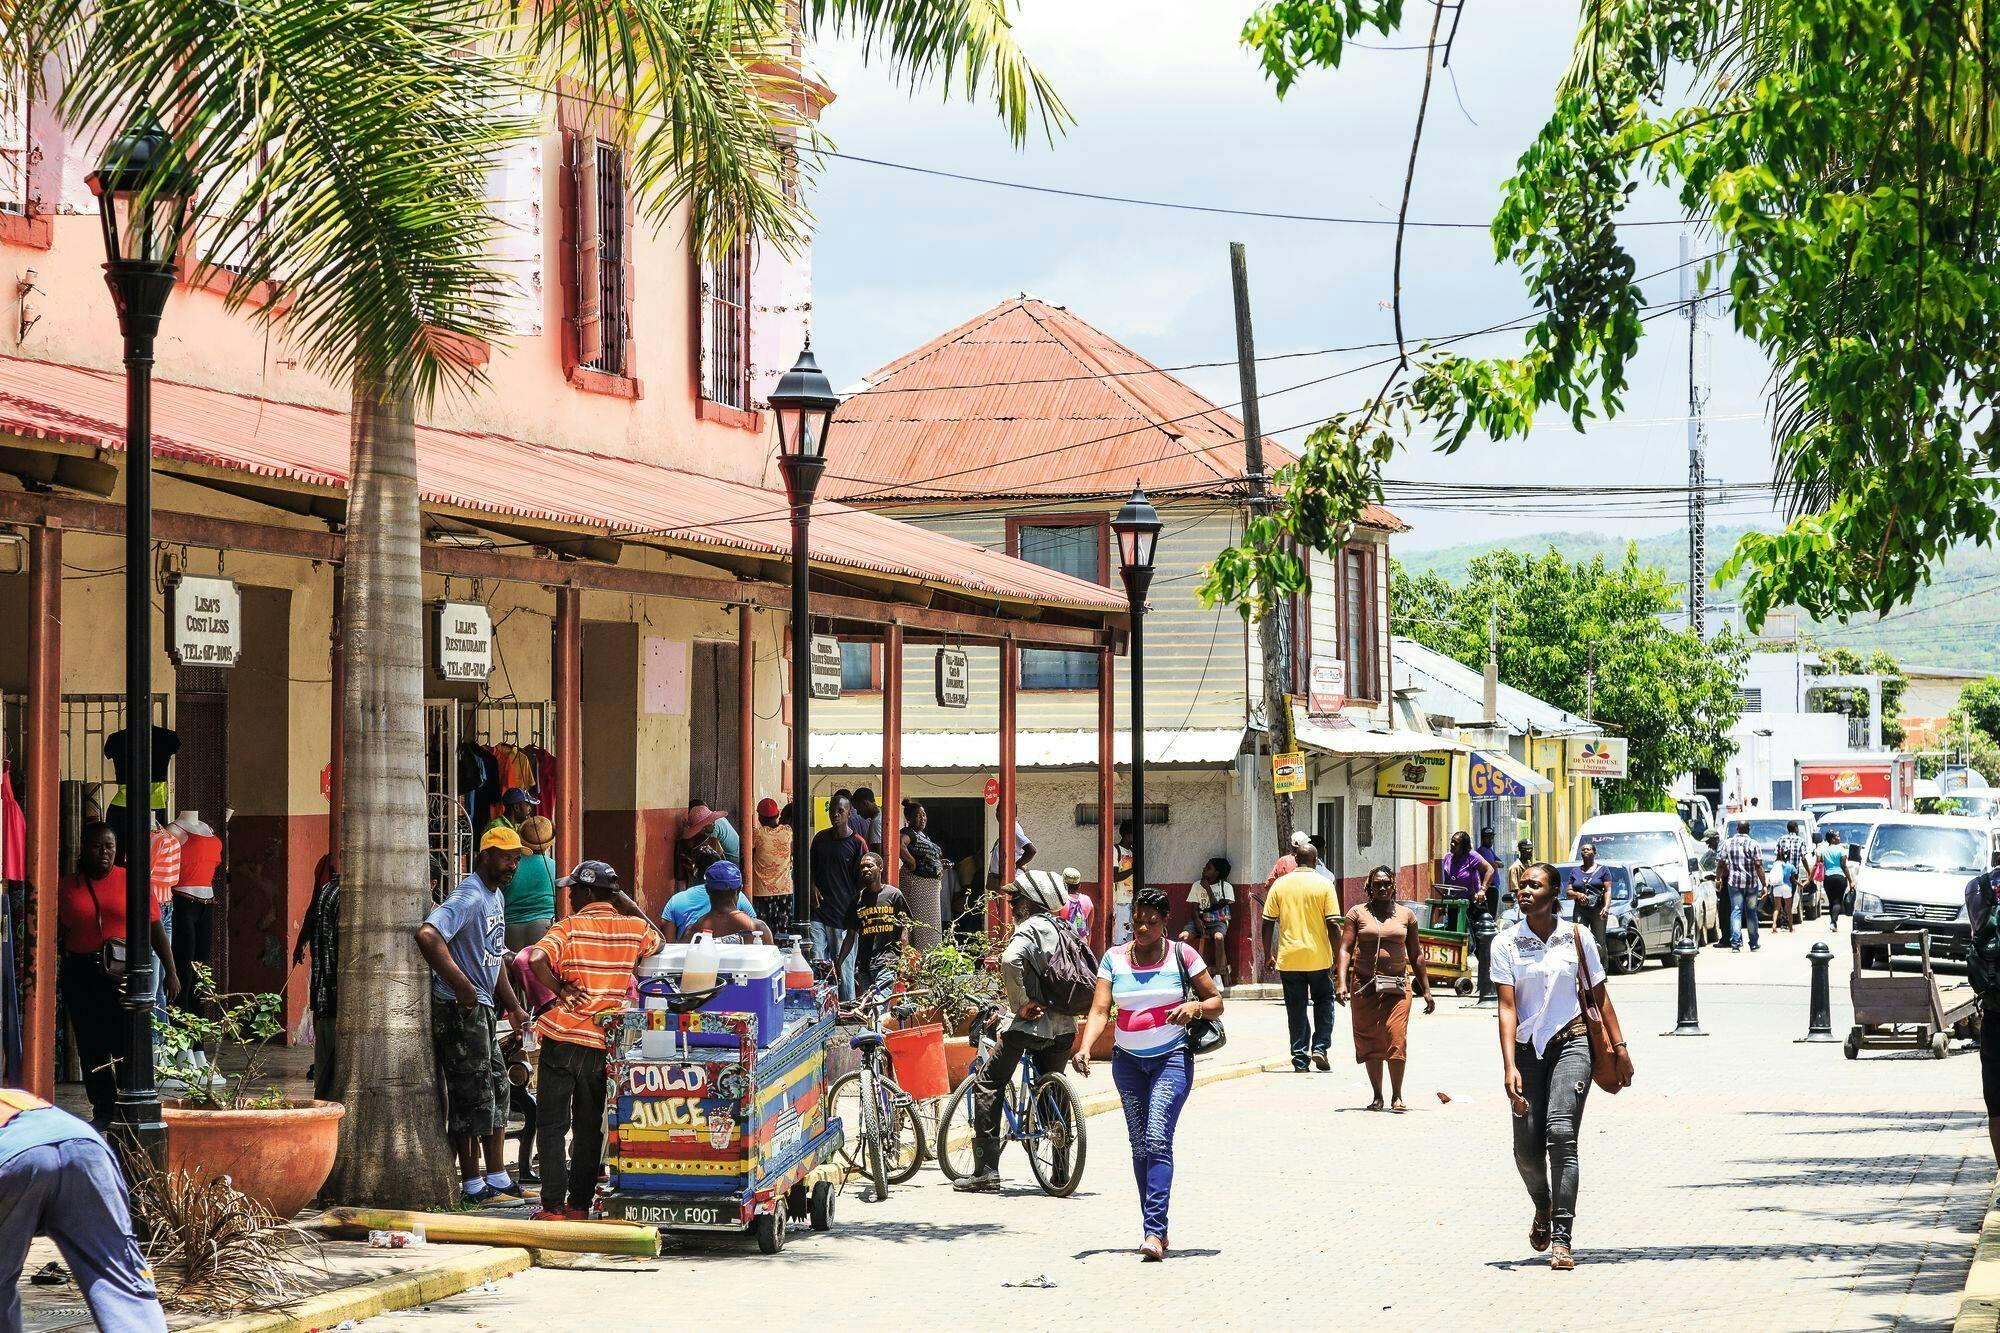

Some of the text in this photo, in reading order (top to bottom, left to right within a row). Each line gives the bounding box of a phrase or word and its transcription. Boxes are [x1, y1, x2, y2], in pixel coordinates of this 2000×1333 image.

[186, 615, 229, 634] COST LESS
[445, 637, 487, 653] RESTAURANT
[629, 1065, 708, 1095] COLD
[630, 1096, 707, 1129] JUICE
[625, 1206, 719, 1223] NO DIRTY FOOT
